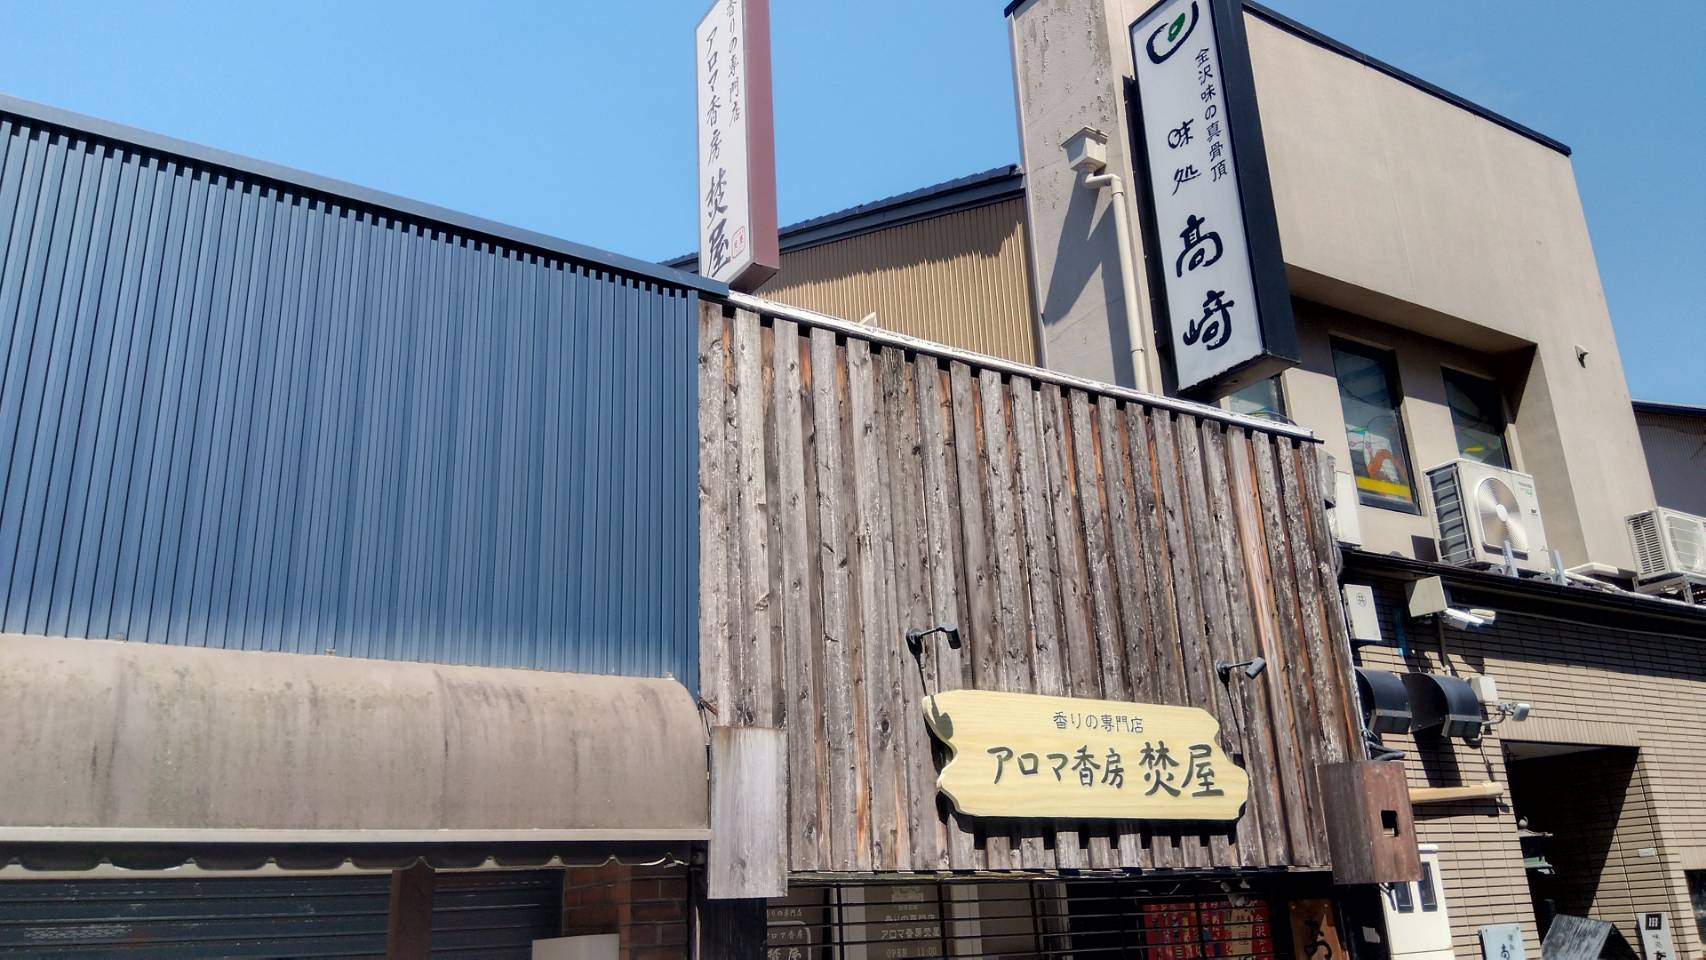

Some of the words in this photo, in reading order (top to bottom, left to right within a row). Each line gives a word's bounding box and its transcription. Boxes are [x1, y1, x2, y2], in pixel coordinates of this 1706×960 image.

[727, 0, 741, 127] 香りの専門店
[1195, 47, 1228, 182] 金沢味の真骨頂
[1053, 711, 1144, 733] 香りの専門店
